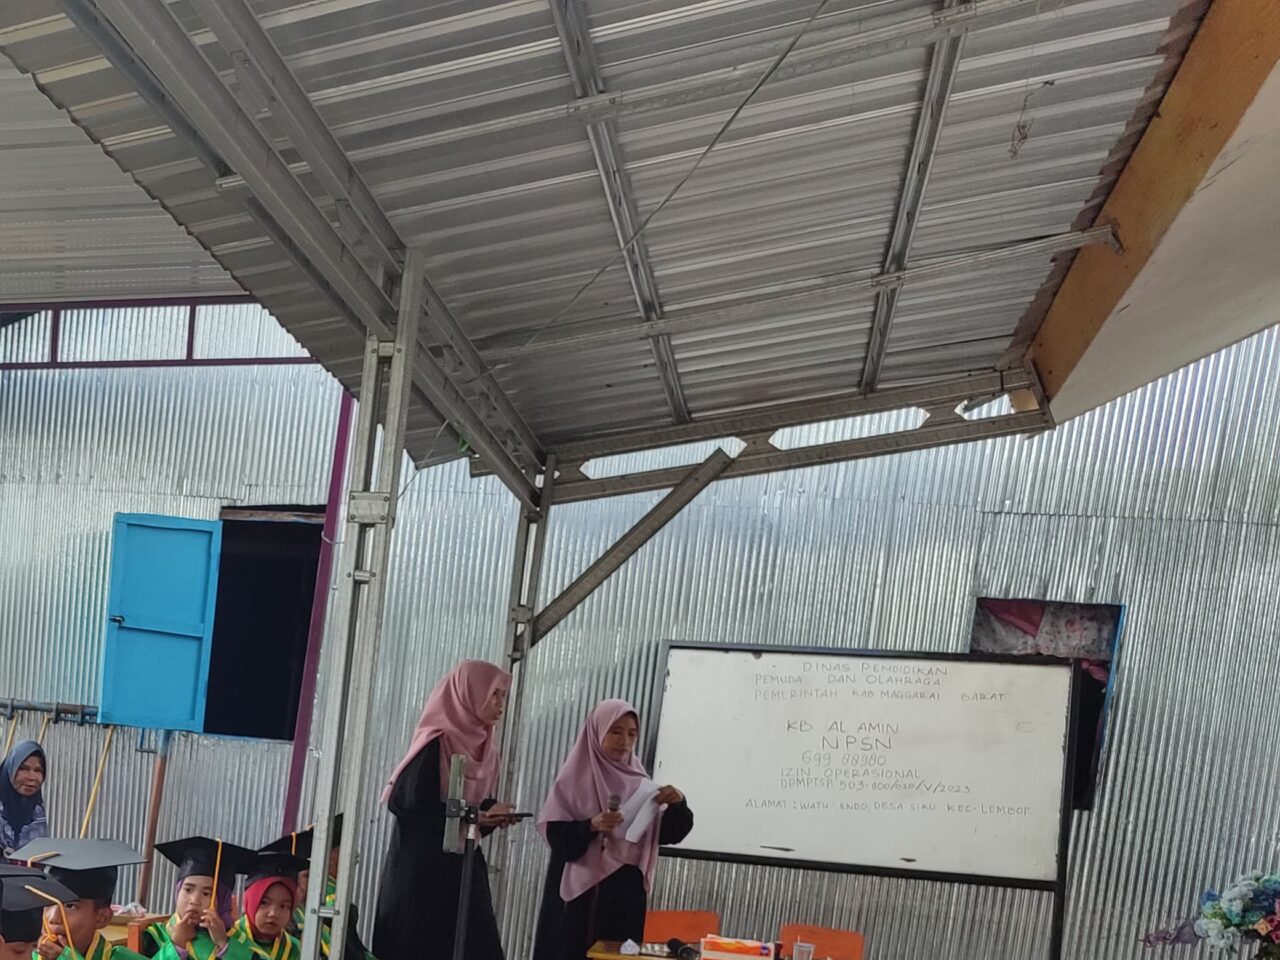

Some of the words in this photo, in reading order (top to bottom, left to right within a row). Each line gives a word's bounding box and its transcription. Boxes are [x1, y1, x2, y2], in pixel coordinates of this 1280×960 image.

[802, 661, 851, 673] DINAS
[861, 662, 948, 676] PENDIDIKAN
[754, 673, 802, 686] PEMUDA
[826, 673, 856, 684] DAN
[865, 674, 941, 686] OLAHRAGA
[754, 688, 838, 701] PEMERINTAH
[960, 692, 1006, 702] BARAT
[786, 719, 813, 732] KB
[827, 720, 846, 733] AL
[856, 721, 899, 734] AMIN
[821, 735, 893, 751] NPSN
[780, 767, 811, 778] IZIN
[823, 768, 919, 780] OPERASIONAL
[745, 798, 788, 809] ALAMAT
[874, 801, 904, 811] DESA
